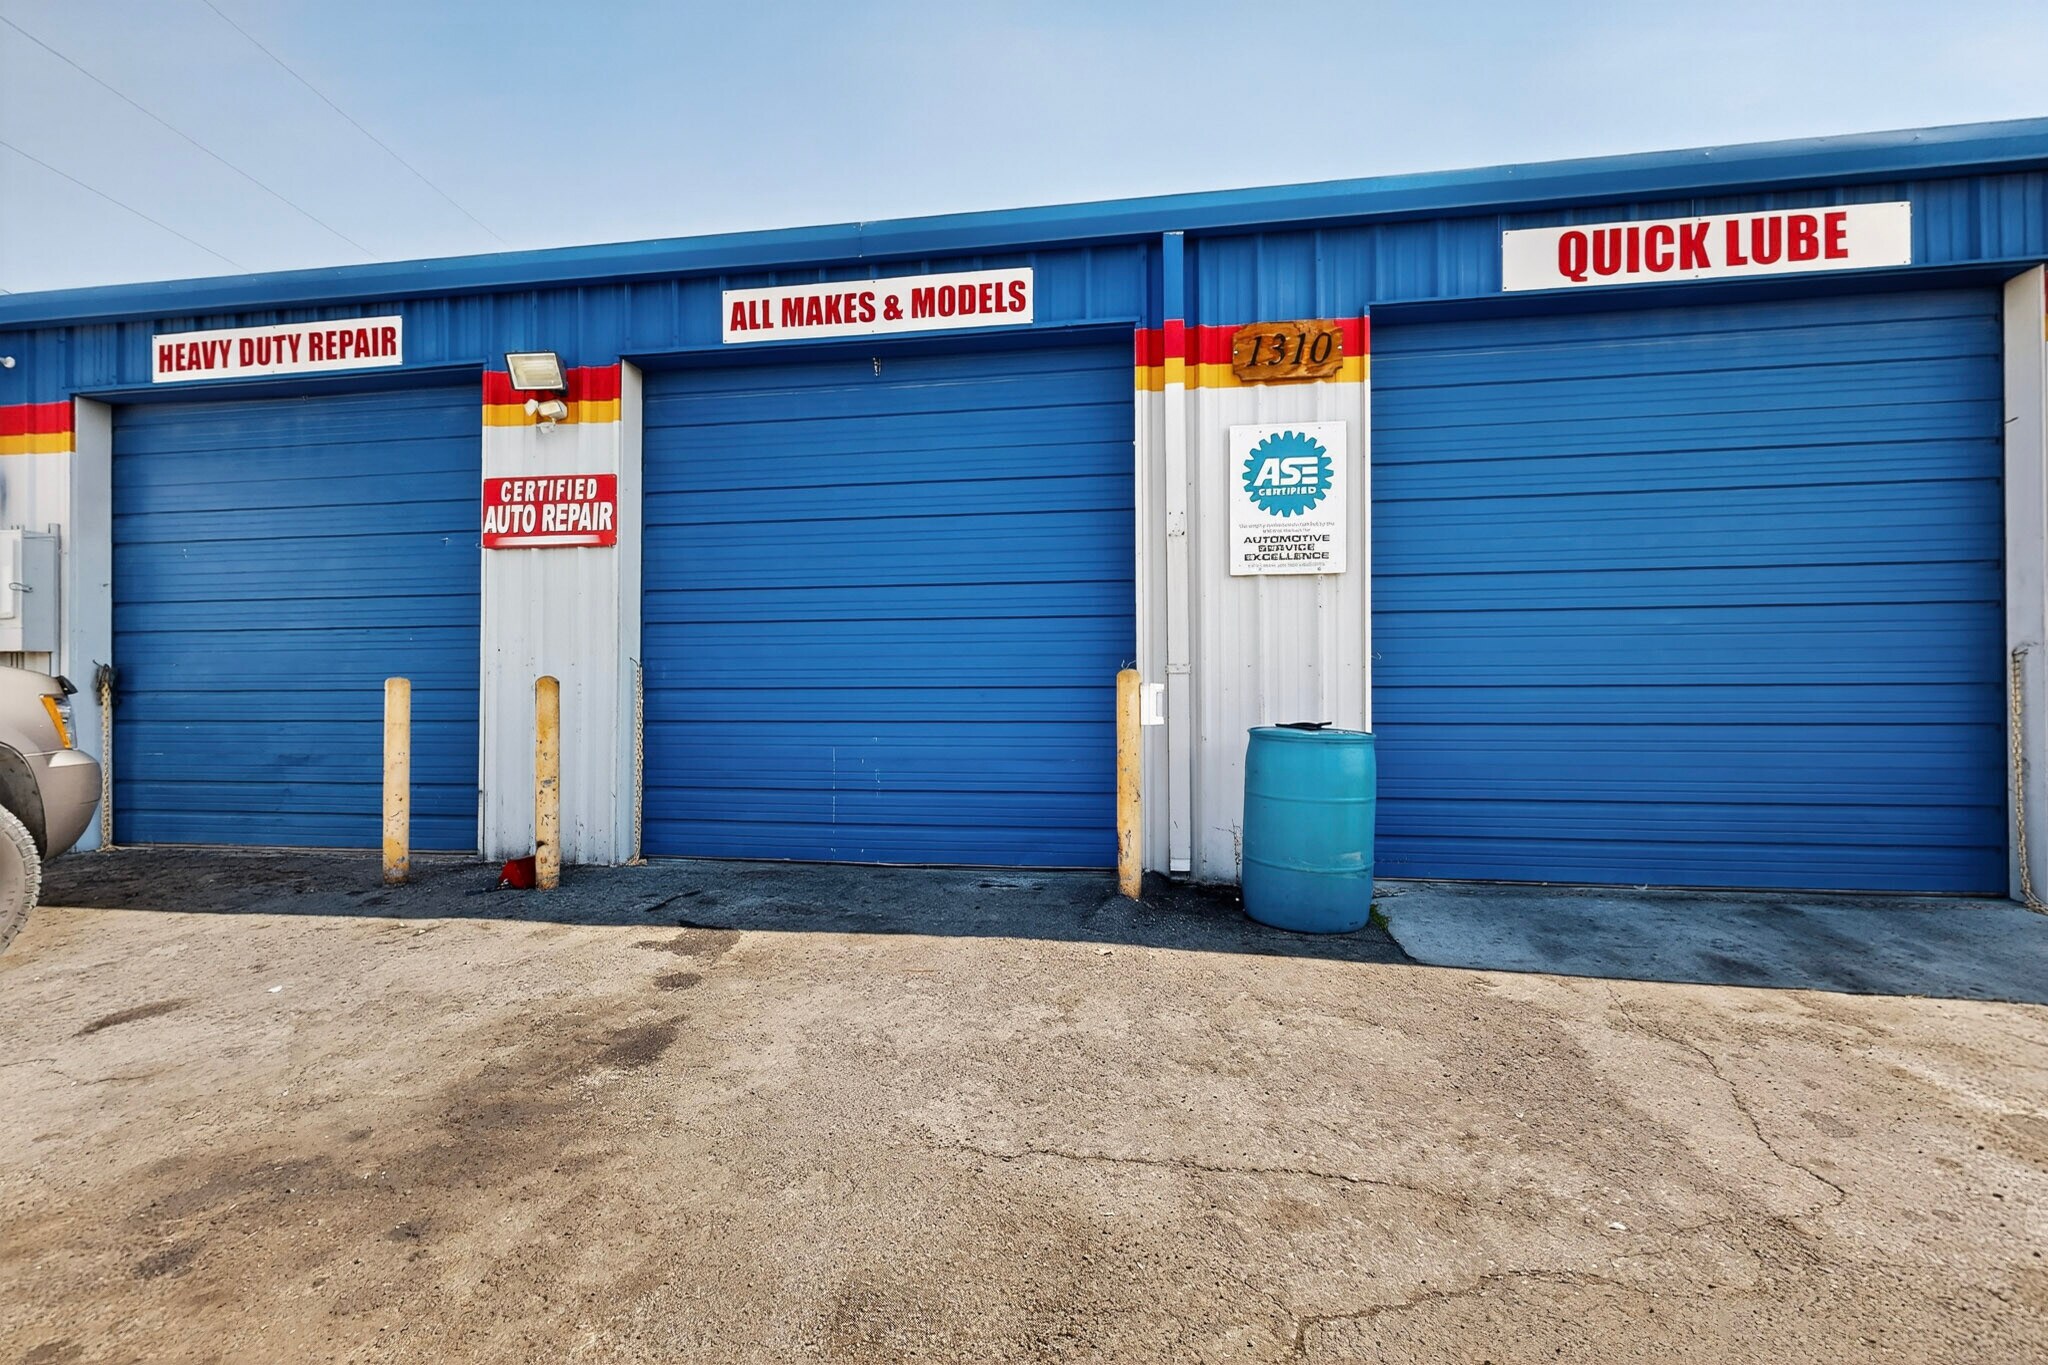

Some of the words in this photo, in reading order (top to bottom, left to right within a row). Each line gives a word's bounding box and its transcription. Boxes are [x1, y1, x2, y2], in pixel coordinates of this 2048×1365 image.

[1557, 221, 1711, 283] QUICK
[1725, 211, 1849, 267] LUBE
[730, 299, 774, 331] ALL
[781, 291, 876, 328] MAKES
[883, 294, 903, 320] &
[911, 280, 1026, 318] MODELS
[158, 338, 232, 373] HEAVY
[239, 333, 302, 368] DUTY
[308, 326, 397, 362] REPAIR
[1246, 332, 1332, 367] 1310
[1253, 456, 1318, 487] ASE
[501, 478, 598, 502] CERTIFIED
[1258, 486, 1317, 496] CERTIFIED
[483, 504, 536, 534] AUTO
[541, 501, 613, 532] REPAIR
[1243, 534, 1330, 544] AUTOMOTIVE
[1258, 543, 1315, 552] SERVICE
[1244, 552, 1330, 561] EXCELLENCE
